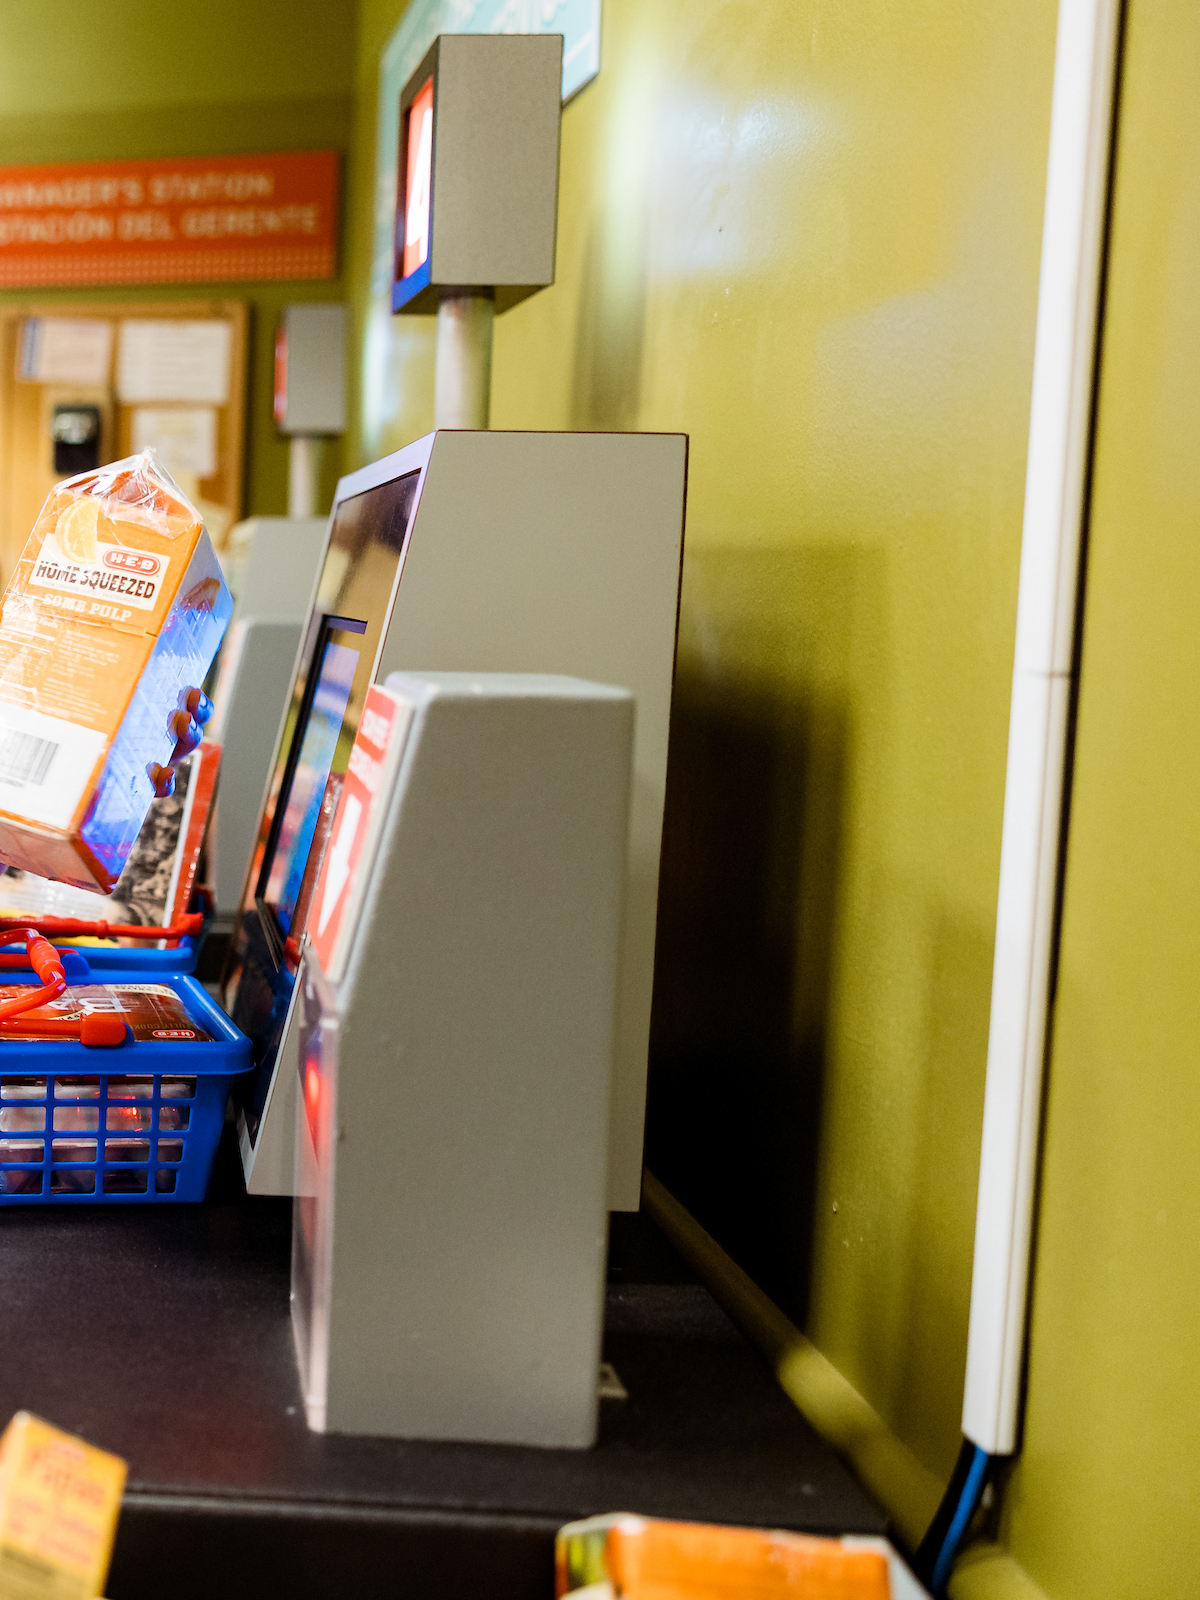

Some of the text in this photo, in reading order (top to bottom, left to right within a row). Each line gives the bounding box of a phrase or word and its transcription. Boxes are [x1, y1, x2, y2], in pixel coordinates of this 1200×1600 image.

[152, 170, 273, 204] STATION
[118, 208, 174, 242] DEL
[180, 203, 318, 239] GERENTE
[36, 560, 79, 583] HOME
[80, 569, 156, 599] SQUEEZED
[42, 593, 87, 613] SOME
[88, 602, 132, 622] PULP
